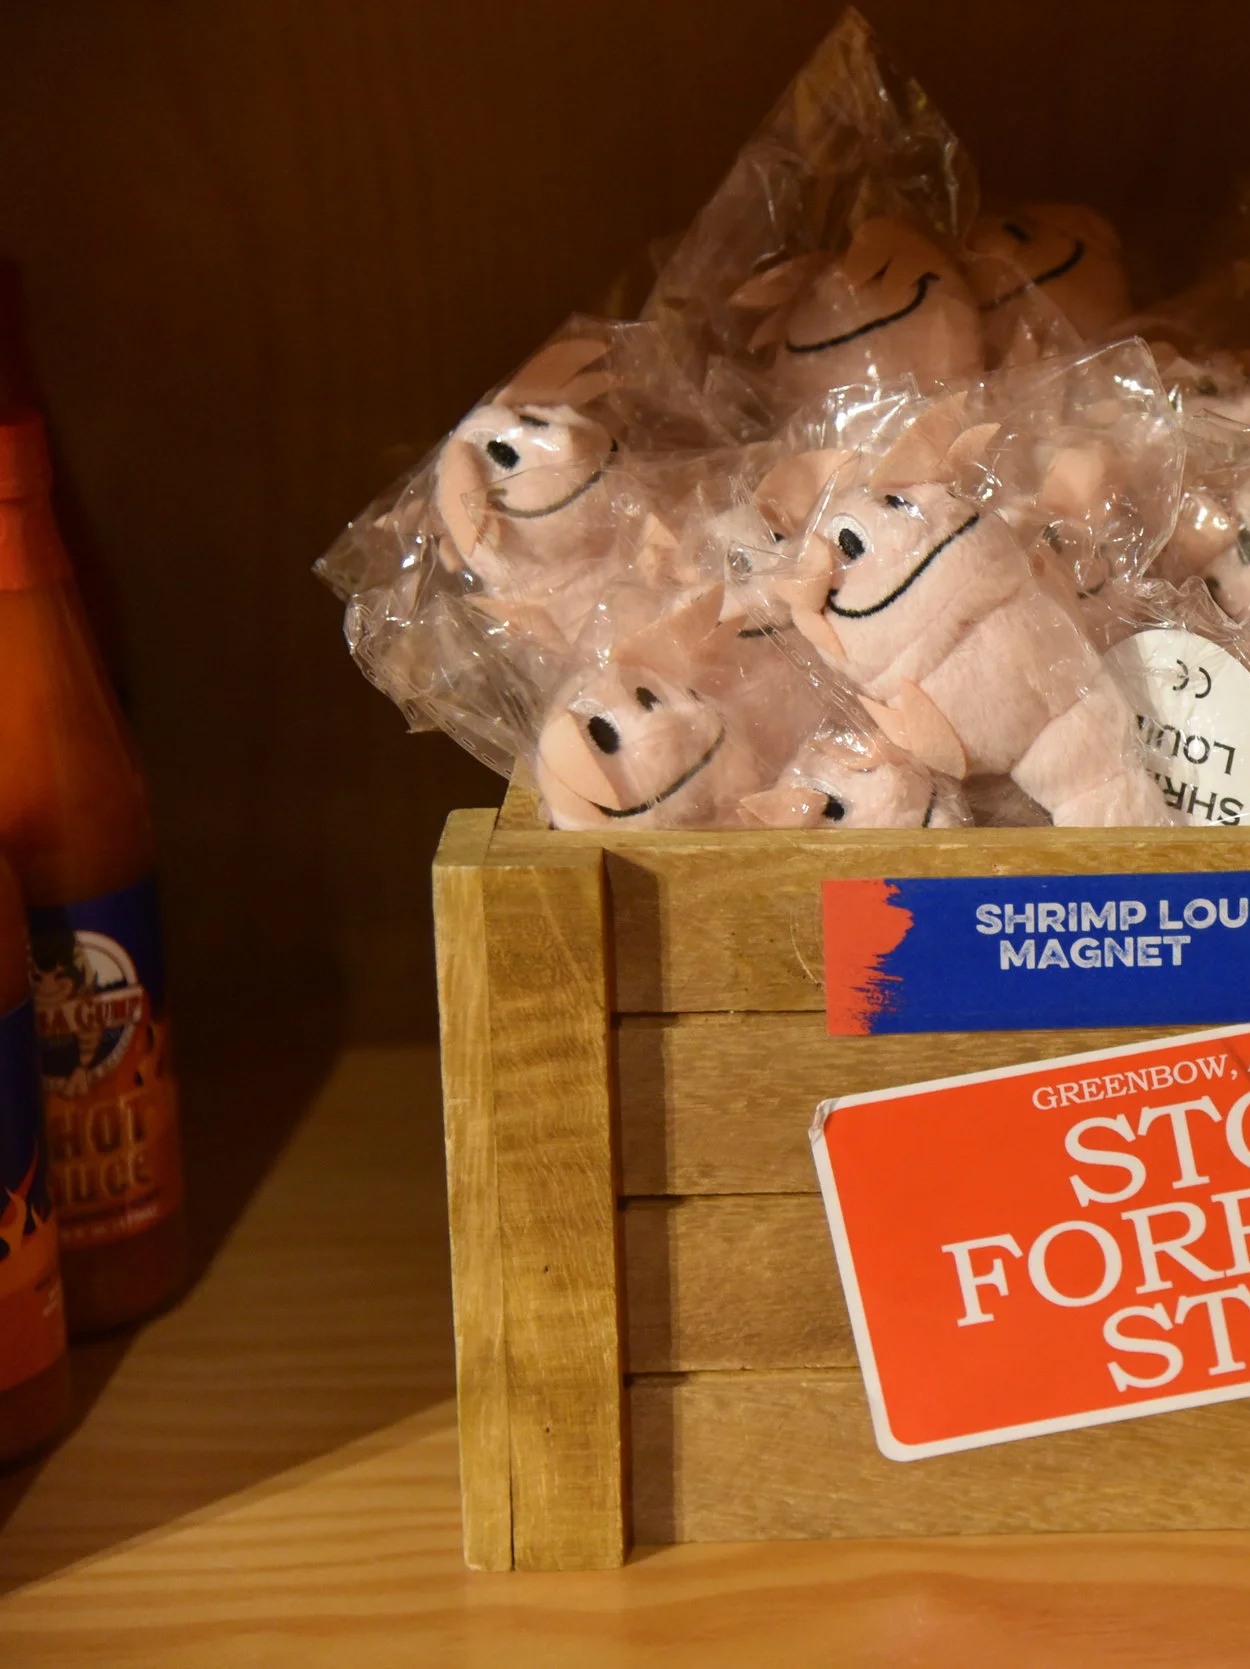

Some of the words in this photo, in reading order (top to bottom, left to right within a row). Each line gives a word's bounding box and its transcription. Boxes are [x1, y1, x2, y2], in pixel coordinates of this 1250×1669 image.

[1135, 713, 1237, 776] LOUI
[975, 900, 1147, 935] SHRIMP
[1000, 935, 1191, 970] MAGNET
[1032, 1054, 1238, 1111] GREENBOW,
